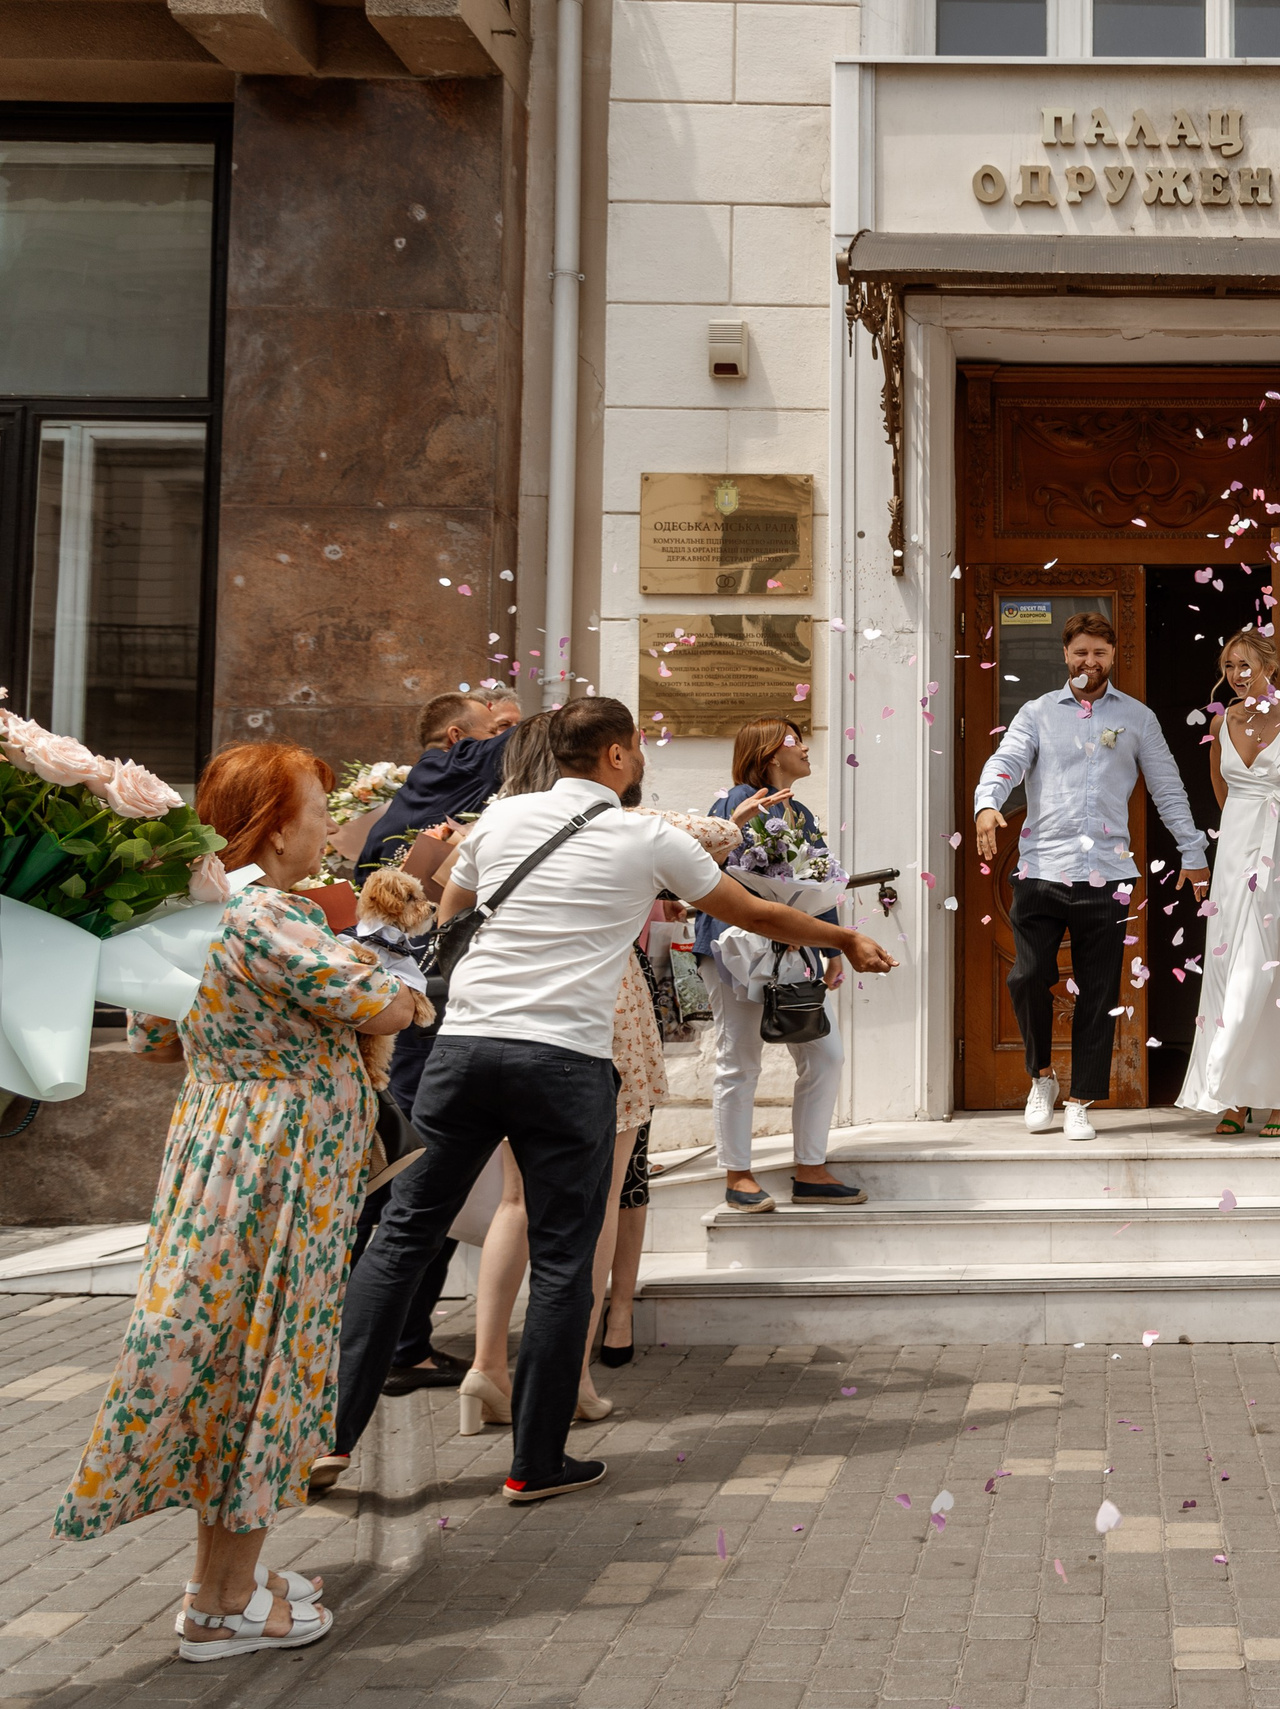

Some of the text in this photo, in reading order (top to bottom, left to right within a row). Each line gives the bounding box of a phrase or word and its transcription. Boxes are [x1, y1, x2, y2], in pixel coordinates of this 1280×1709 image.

[1041, 106, 1244, 158] ПАЛАЦ
[653, 521, 796, 534] ОДЕСЬКА МІСЬКА РАДА
[653, 537, 705, 545] КОМУНАЛЬНЕ
[661, 546, 686, 554] ВІДДІЛ
[711, 555, 754, 563] РЕЄСТРАЦІЇ
[755, 555, 783, 563] ШЛЮБУ
